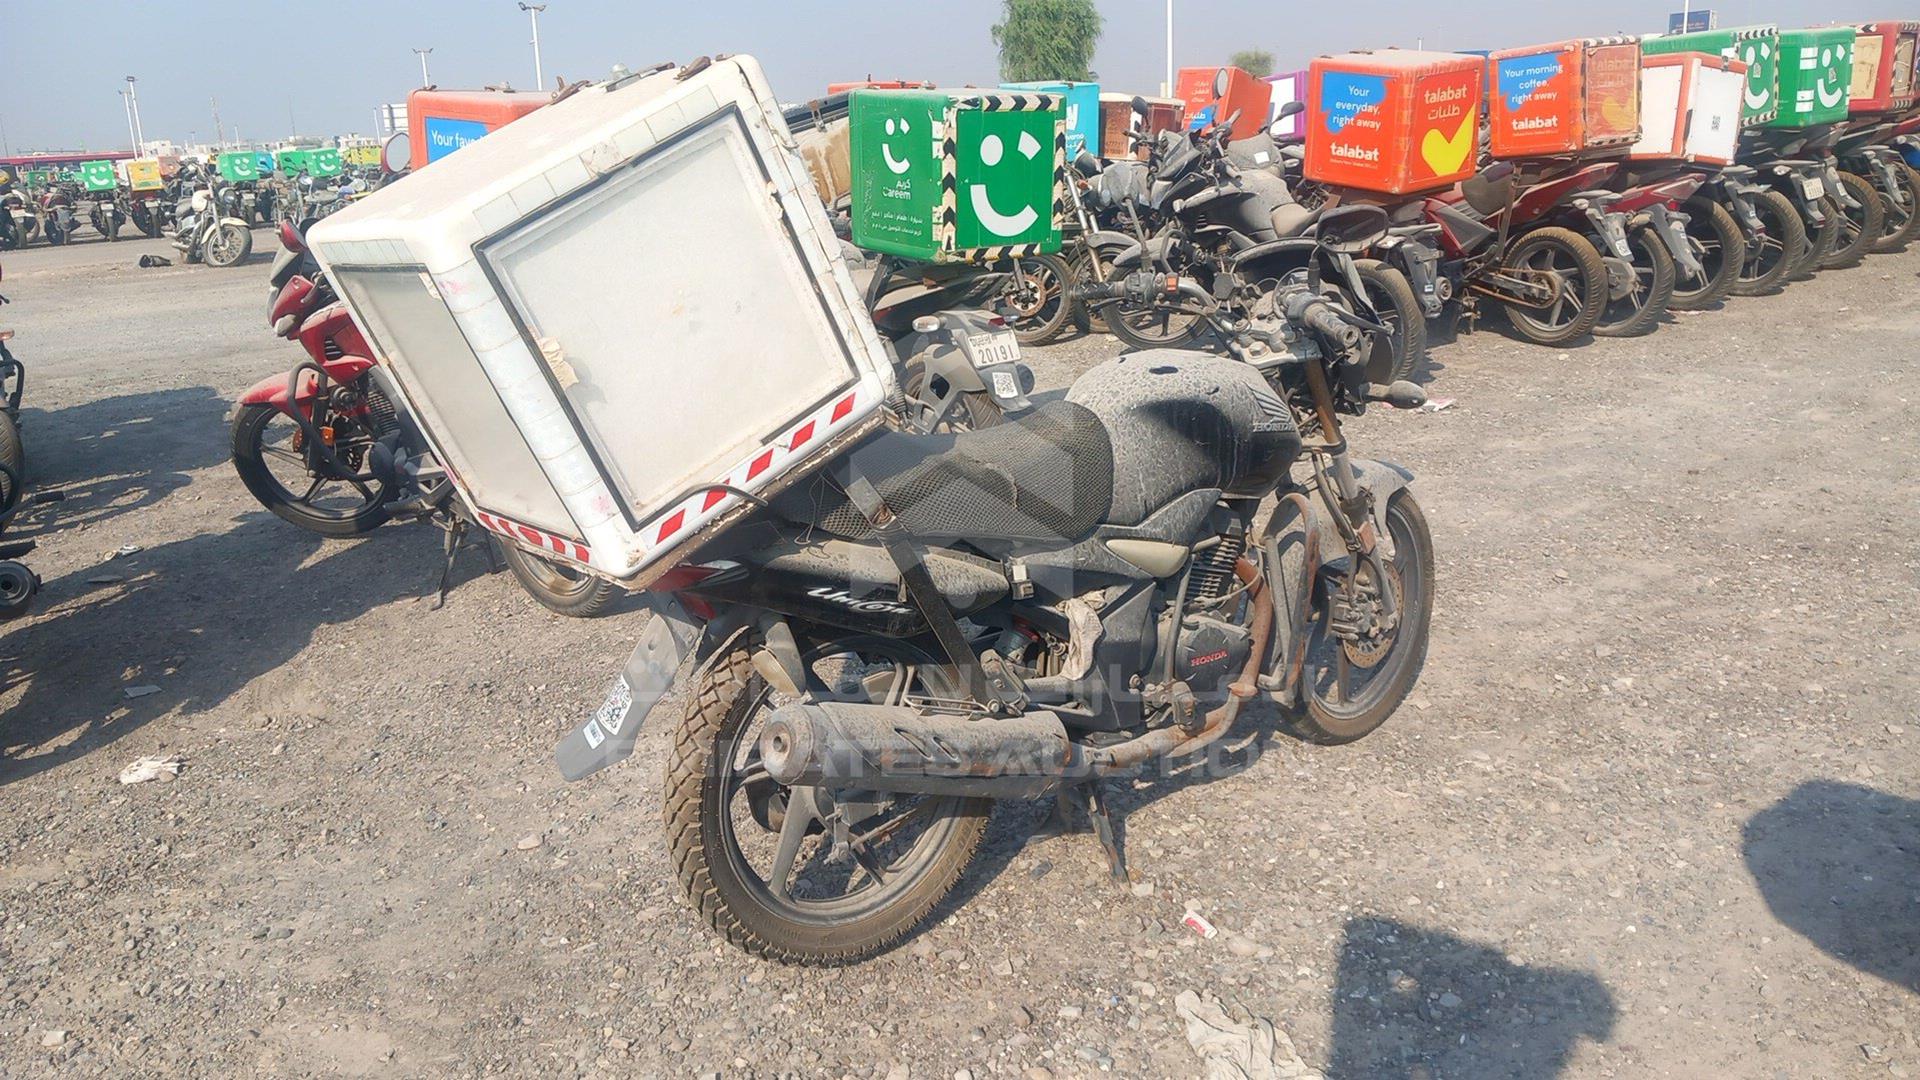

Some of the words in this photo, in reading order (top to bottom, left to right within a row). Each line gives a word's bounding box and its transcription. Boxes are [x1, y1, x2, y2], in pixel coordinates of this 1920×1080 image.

[1505, 69, 1525, 78] Your
[1526, 64, 1563, 76] morning
[1348, 85, 1370, 97] Your
[1424, 84, 1467, 104] talabat
[1511, 92, 1533, 105] right
[1534, 92, 1557, 101] away
[1335, 101, 1381, 115] everyday,
[1427, 104, 1460, 122] طلبات
[1332, 114, 1355, 128] right
[1356, 119, 1381, 132] away
[1512, 115, 1558, 130] talabat
[431, 129, 453, 148] Your
[1330, 142, 1379, 161] talabat
[882, 186, 911, 200] Careem
[978, 344, 1014, 364] 20191
[1252, 422, 1296, 432] HONDA
[1190, 650, 1228, 667] HONDA
